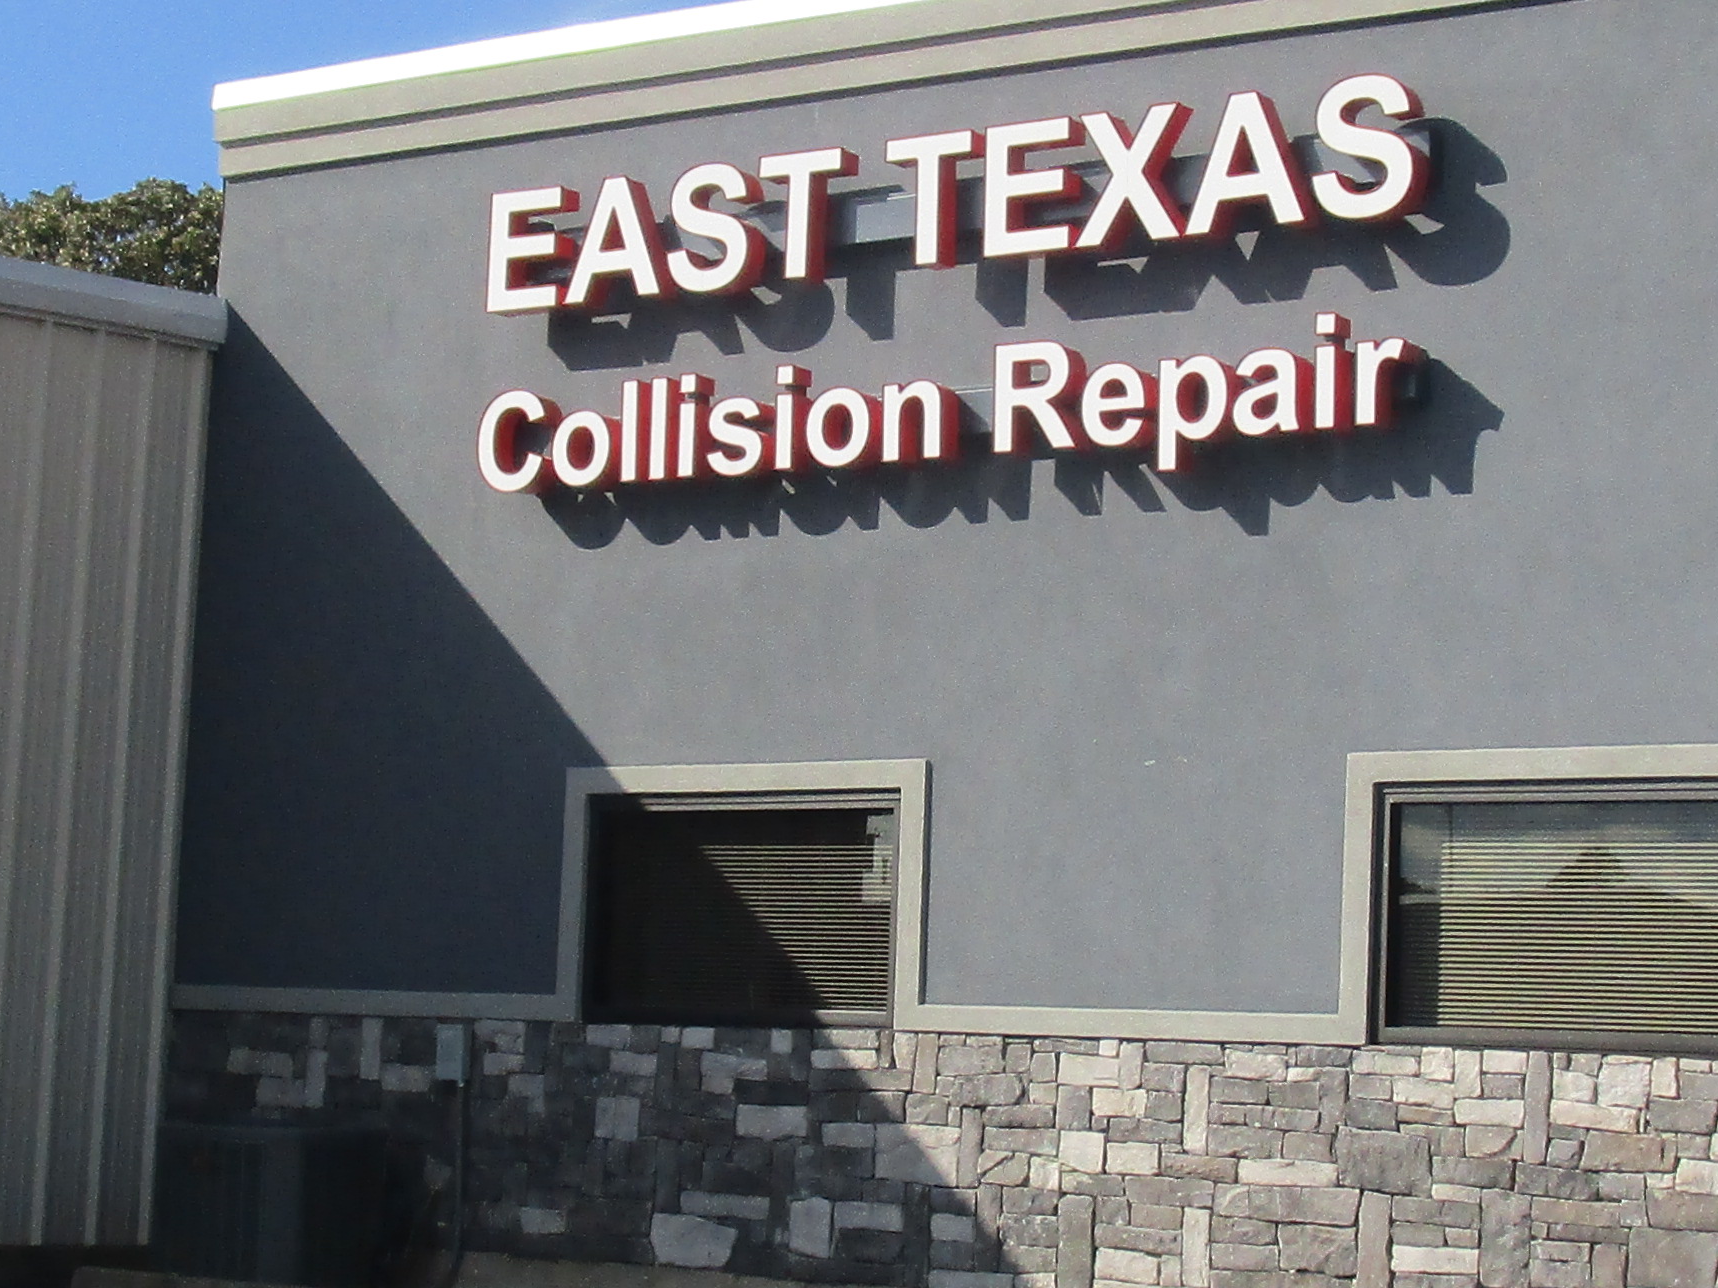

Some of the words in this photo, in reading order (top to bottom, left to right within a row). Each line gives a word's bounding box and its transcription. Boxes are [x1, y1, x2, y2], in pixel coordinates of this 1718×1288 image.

[485, 147, 856, 313] EAST
[884, 73, 1427, 269] TEXAS
[477, 364, 958, 496] Collision
[991, 312, 1413, 473] Repair
